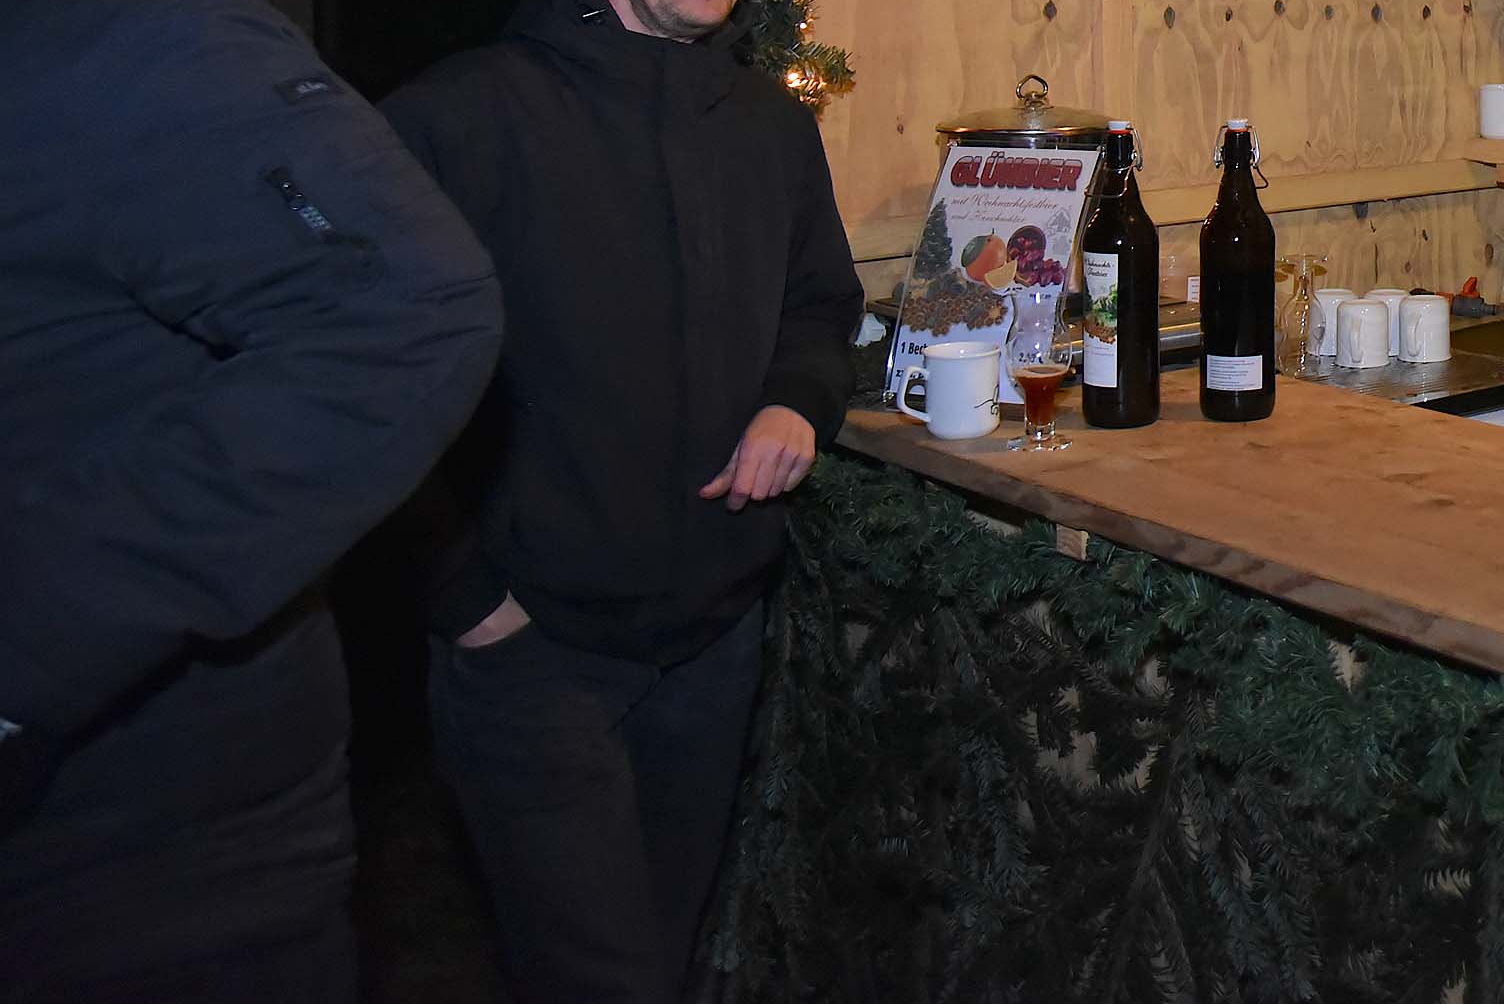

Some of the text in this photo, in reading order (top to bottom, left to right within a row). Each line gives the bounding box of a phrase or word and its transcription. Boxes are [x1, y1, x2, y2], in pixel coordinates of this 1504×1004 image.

[950, 150, 1083, 191] GLÜHBIER
[901, 341, 928, 355] 1 Bec
